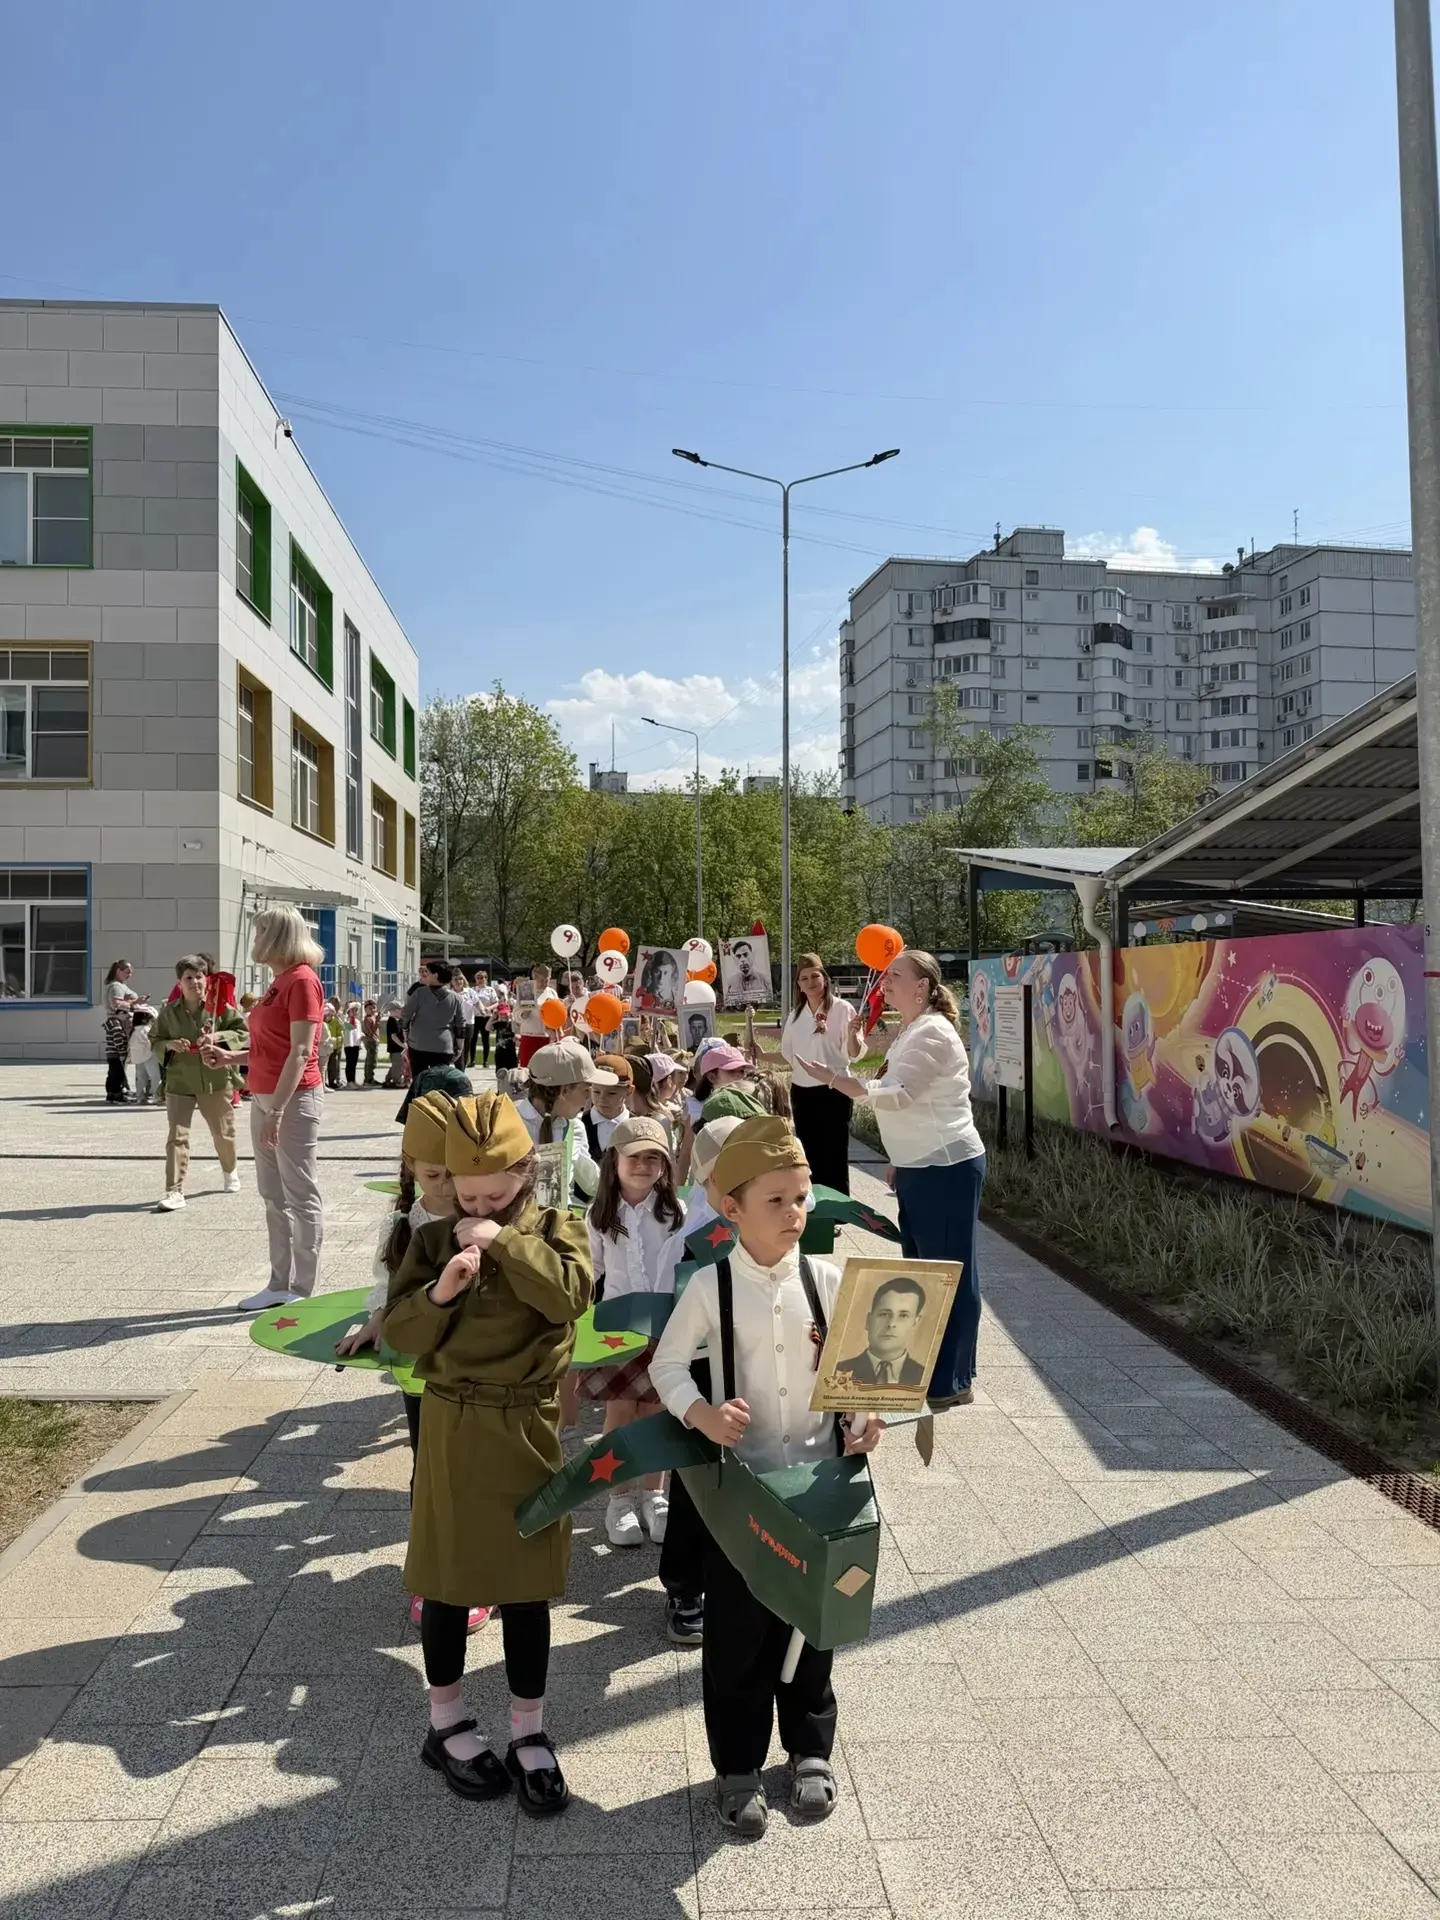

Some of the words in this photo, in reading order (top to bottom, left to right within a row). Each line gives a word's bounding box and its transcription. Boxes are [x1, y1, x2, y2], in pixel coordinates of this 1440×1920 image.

[563, 929, 574, 943] 9
[689, 939, 699, 951] 9
[603, 956, 614, 971] 9
[571, 1008, 578, 1023] 9
